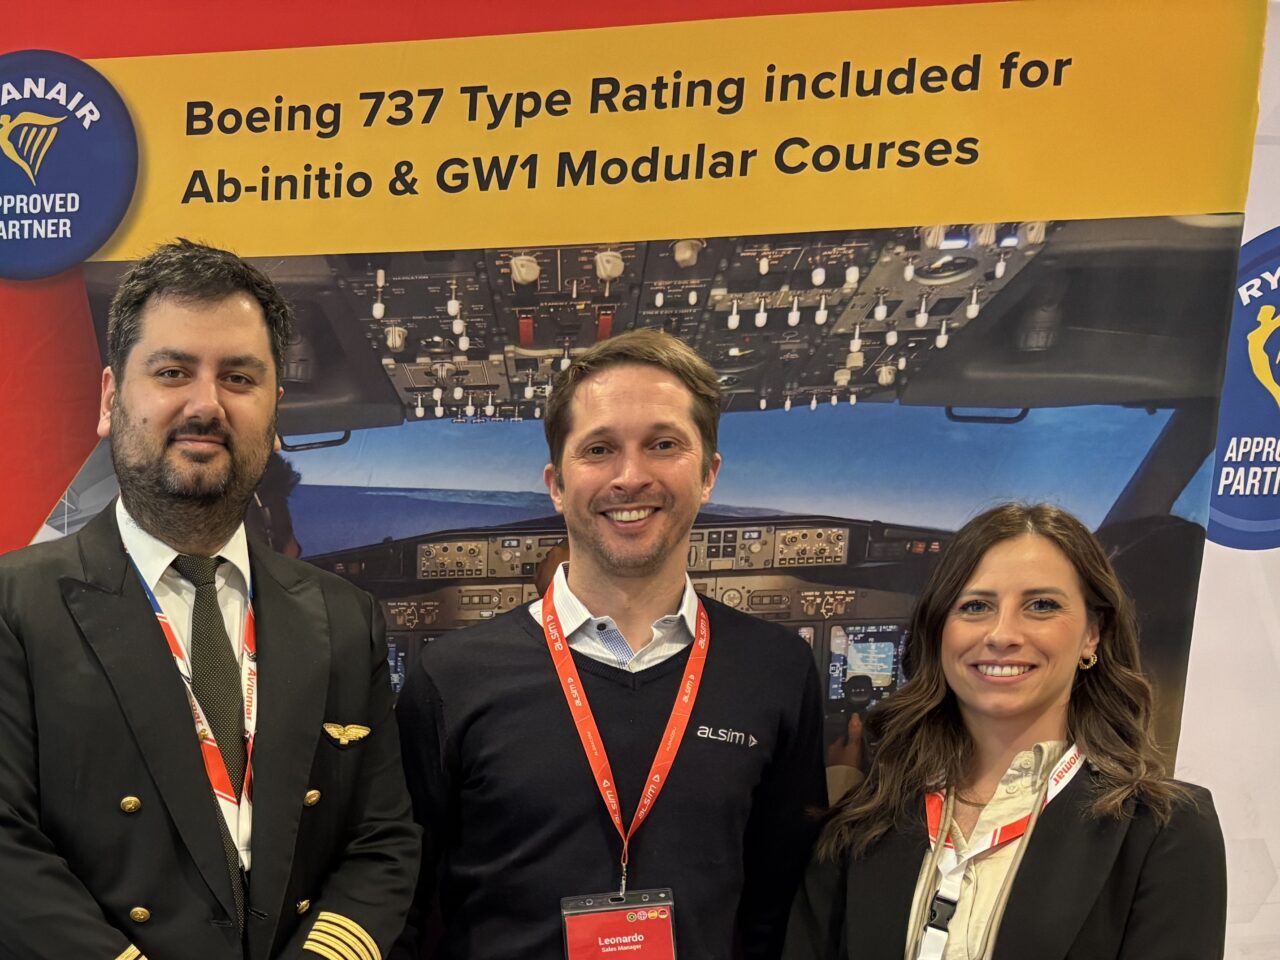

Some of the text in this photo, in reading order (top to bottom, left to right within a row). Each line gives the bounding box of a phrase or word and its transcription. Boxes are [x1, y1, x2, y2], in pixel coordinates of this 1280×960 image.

[185, 51, 1073, 138] Boeing 737 Type Rating included for
[182, 131, 981, 204] Ab-initio & GW1 Modular Courses
[246, 666, 257, 722] Aviomar
[598, 932, 644, 946] Leonardo
[617, 944, 642, 952] Manager
